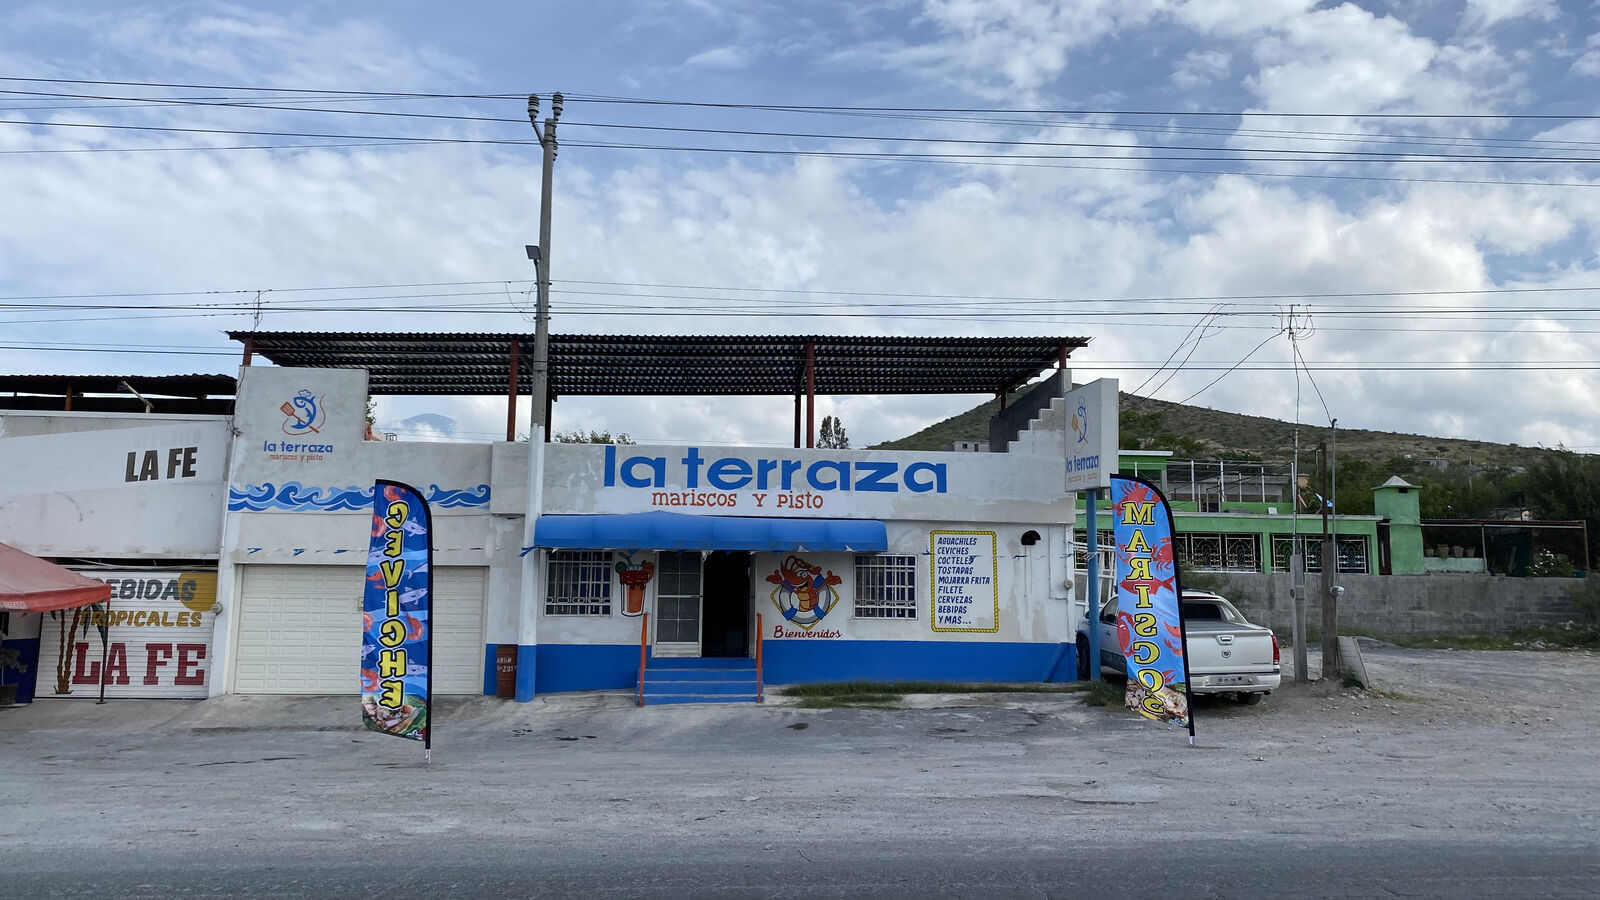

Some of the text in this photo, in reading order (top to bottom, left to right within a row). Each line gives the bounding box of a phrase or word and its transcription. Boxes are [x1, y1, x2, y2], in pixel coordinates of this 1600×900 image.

[264, 440, 333, 453] la terraza
[125, 447, 198, 482] LA FE
[604, 445, 948, 493] la terraza
[1074, 455, 1099, 471] terraza
[652, 489, 737, 507] mariscos
[937, 537, 977, 546] AGUACHILES
[937, 547, 969, 555] CEVICHES
[937, 566, 973, 575] TOSTADAS
[938, 576, 990, 585] MOJARRA FRITA
[97, 579, 197, 601] EBIDAS
[938, 586, 963, 594] FILETE
[938, 596, 973, 604] CERVEZAS
[938, 606, 967, 614] BEBIDAS
[79, 611, 202, 627] TROPICALES
[938, 616, 943, 624] Y
[773, 625, 843, 638] Bienvenidos
[72, 642, 207, 685] LA FE
